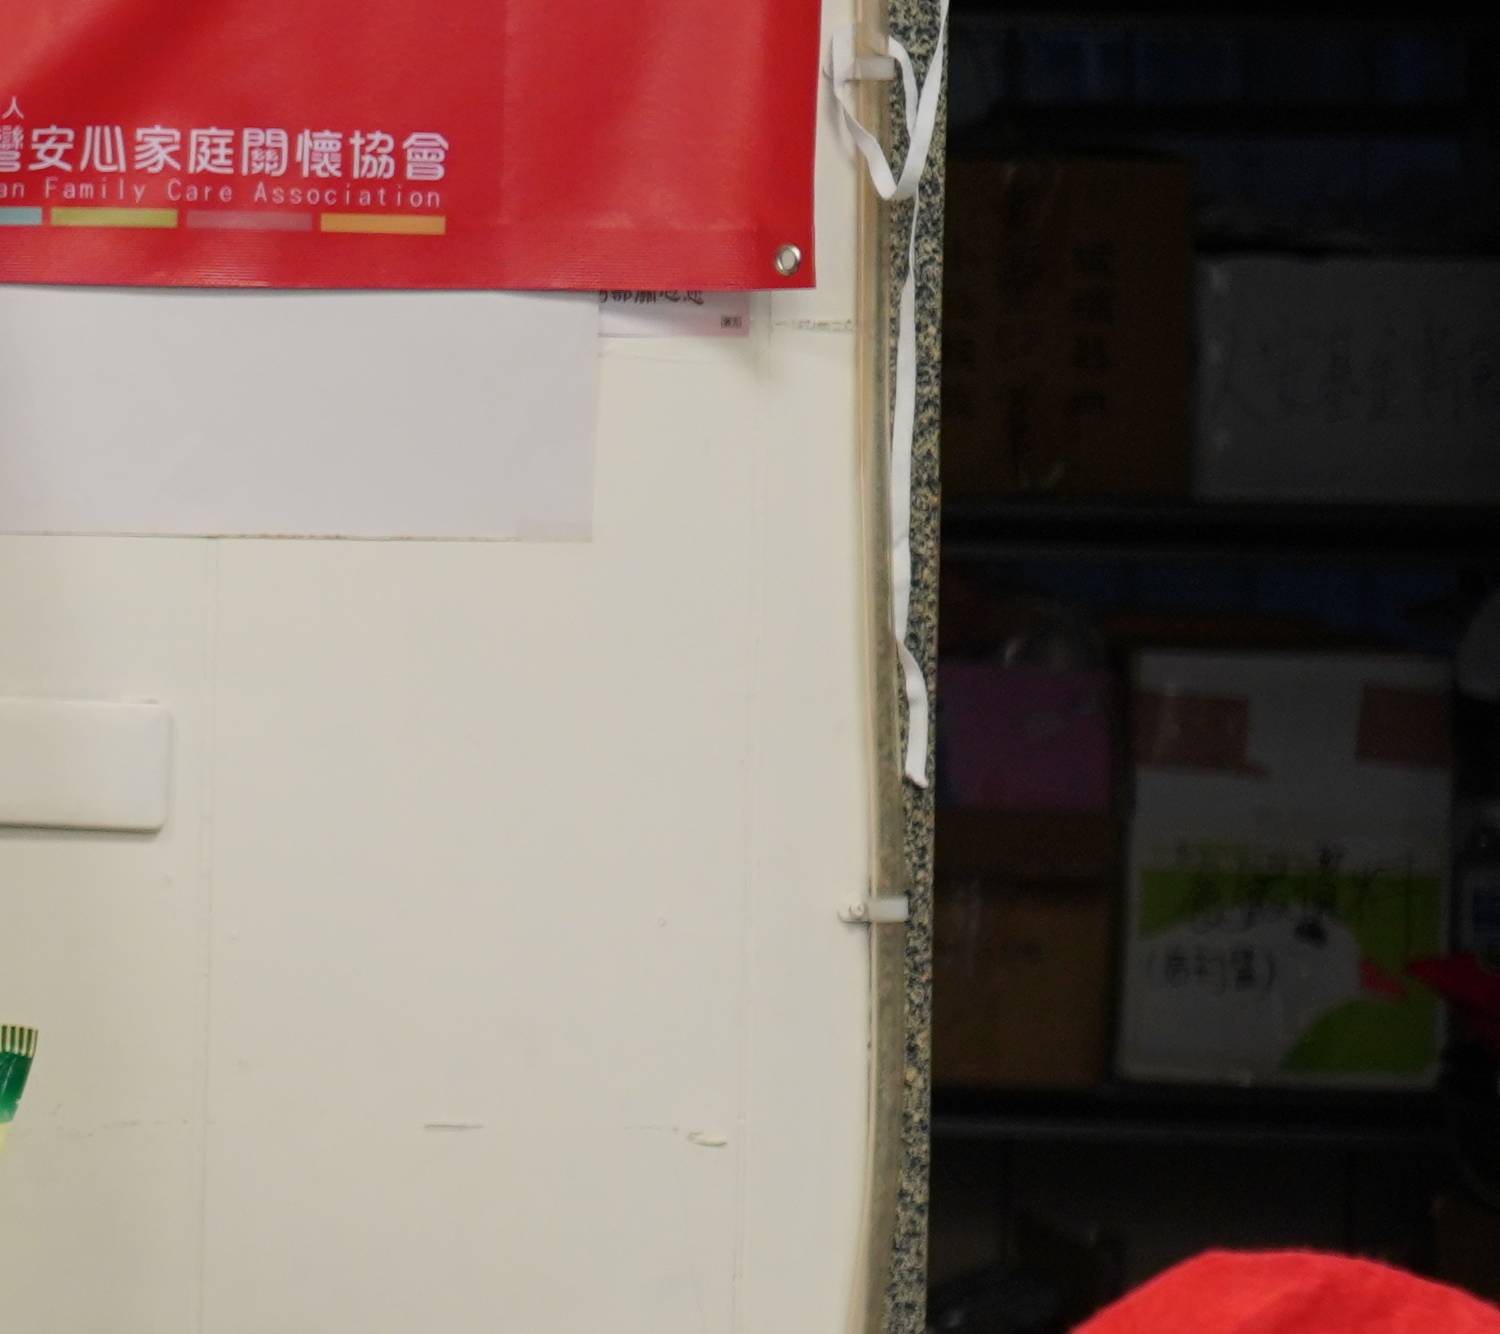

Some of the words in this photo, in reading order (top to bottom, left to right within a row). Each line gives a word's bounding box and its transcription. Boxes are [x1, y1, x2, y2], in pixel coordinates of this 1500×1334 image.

[43, 178, 148, 203] Family
[167, 179, 235, 203] Care
[254, 181, 443, 208] Association
